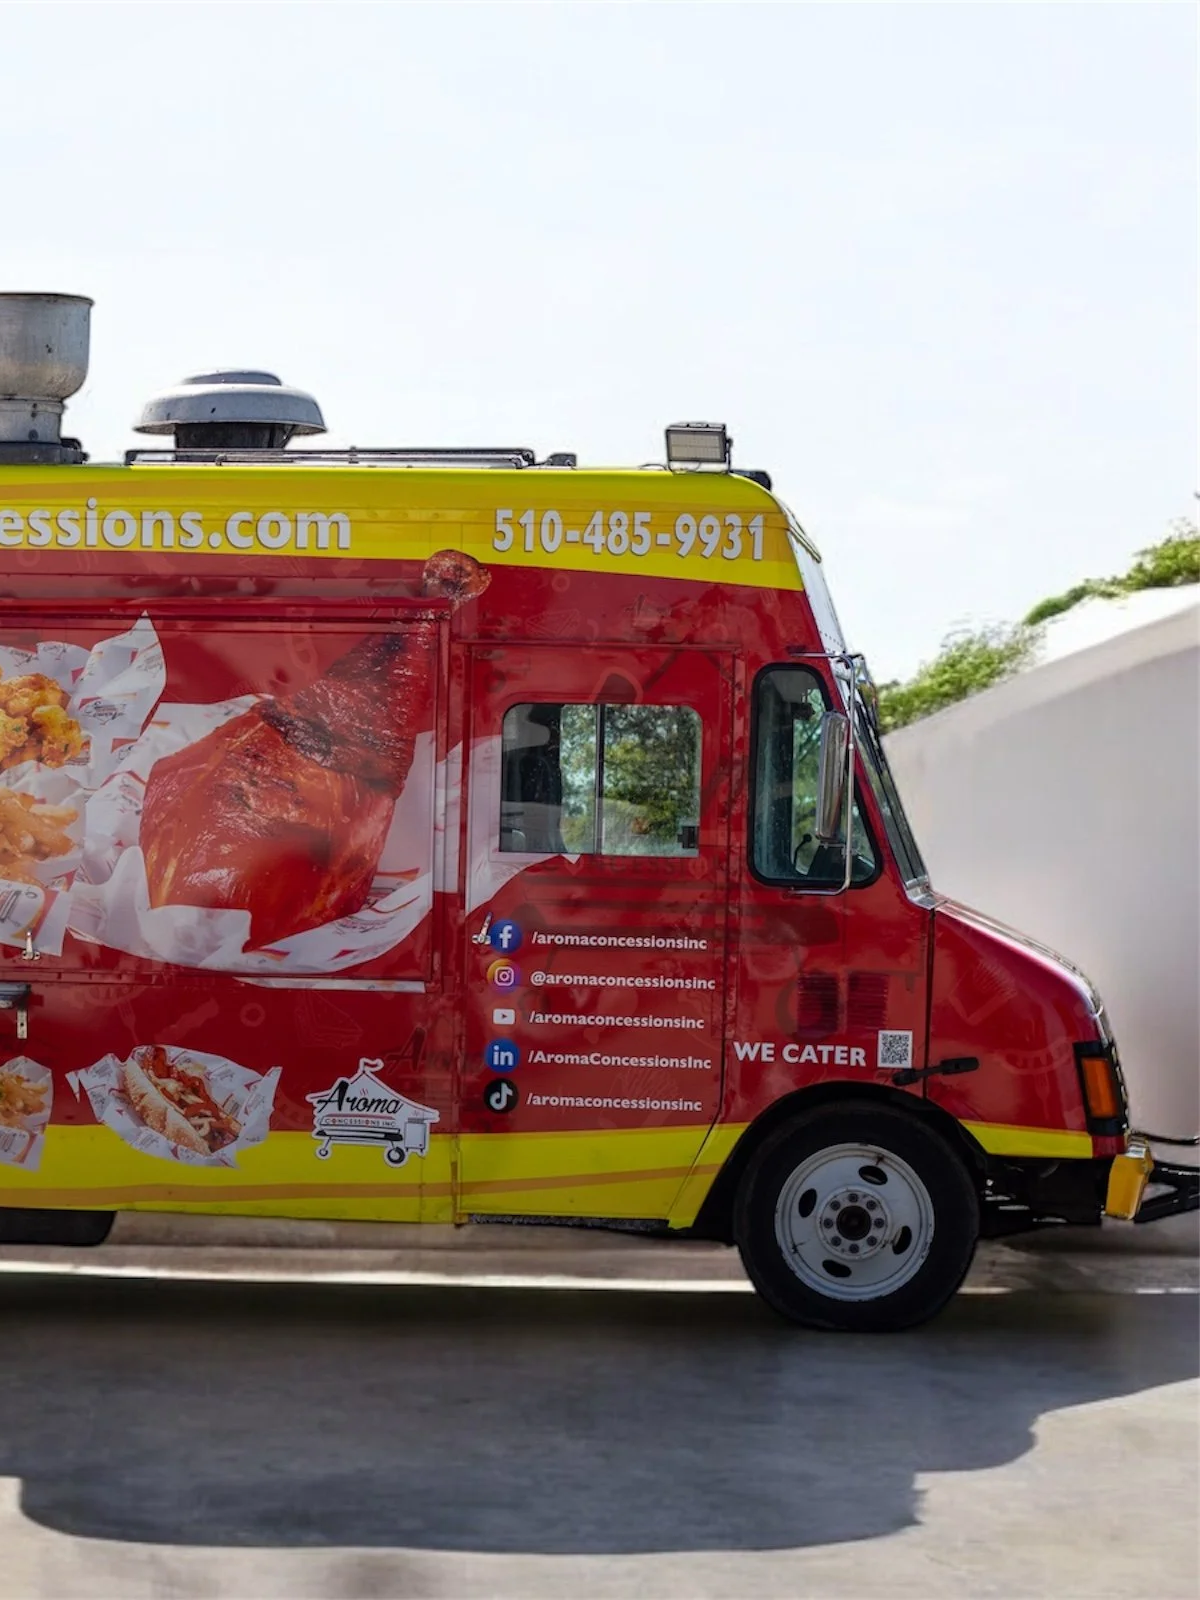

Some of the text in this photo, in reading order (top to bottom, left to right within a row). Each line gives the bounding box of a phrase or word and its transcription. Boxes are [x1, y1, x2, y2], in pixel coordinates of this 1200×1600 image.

[492, 507, 765, 561] 510-485-9931
[532, 931, 708, 950] /aromaconcessionsinc
[530, 971, 716, 990] @aromaconcessionsinc
[528, 1011, 705, 1029] /aromaconcessionsinc
[528, 1050, 712, 1069] /AromaConcessionsInc
[733, 1042, 866, 1067] WE CATER
[317, 1080, 404, 1114] Aroma
[526, 1092, 703, 1111] /aromaconcessionsinc
